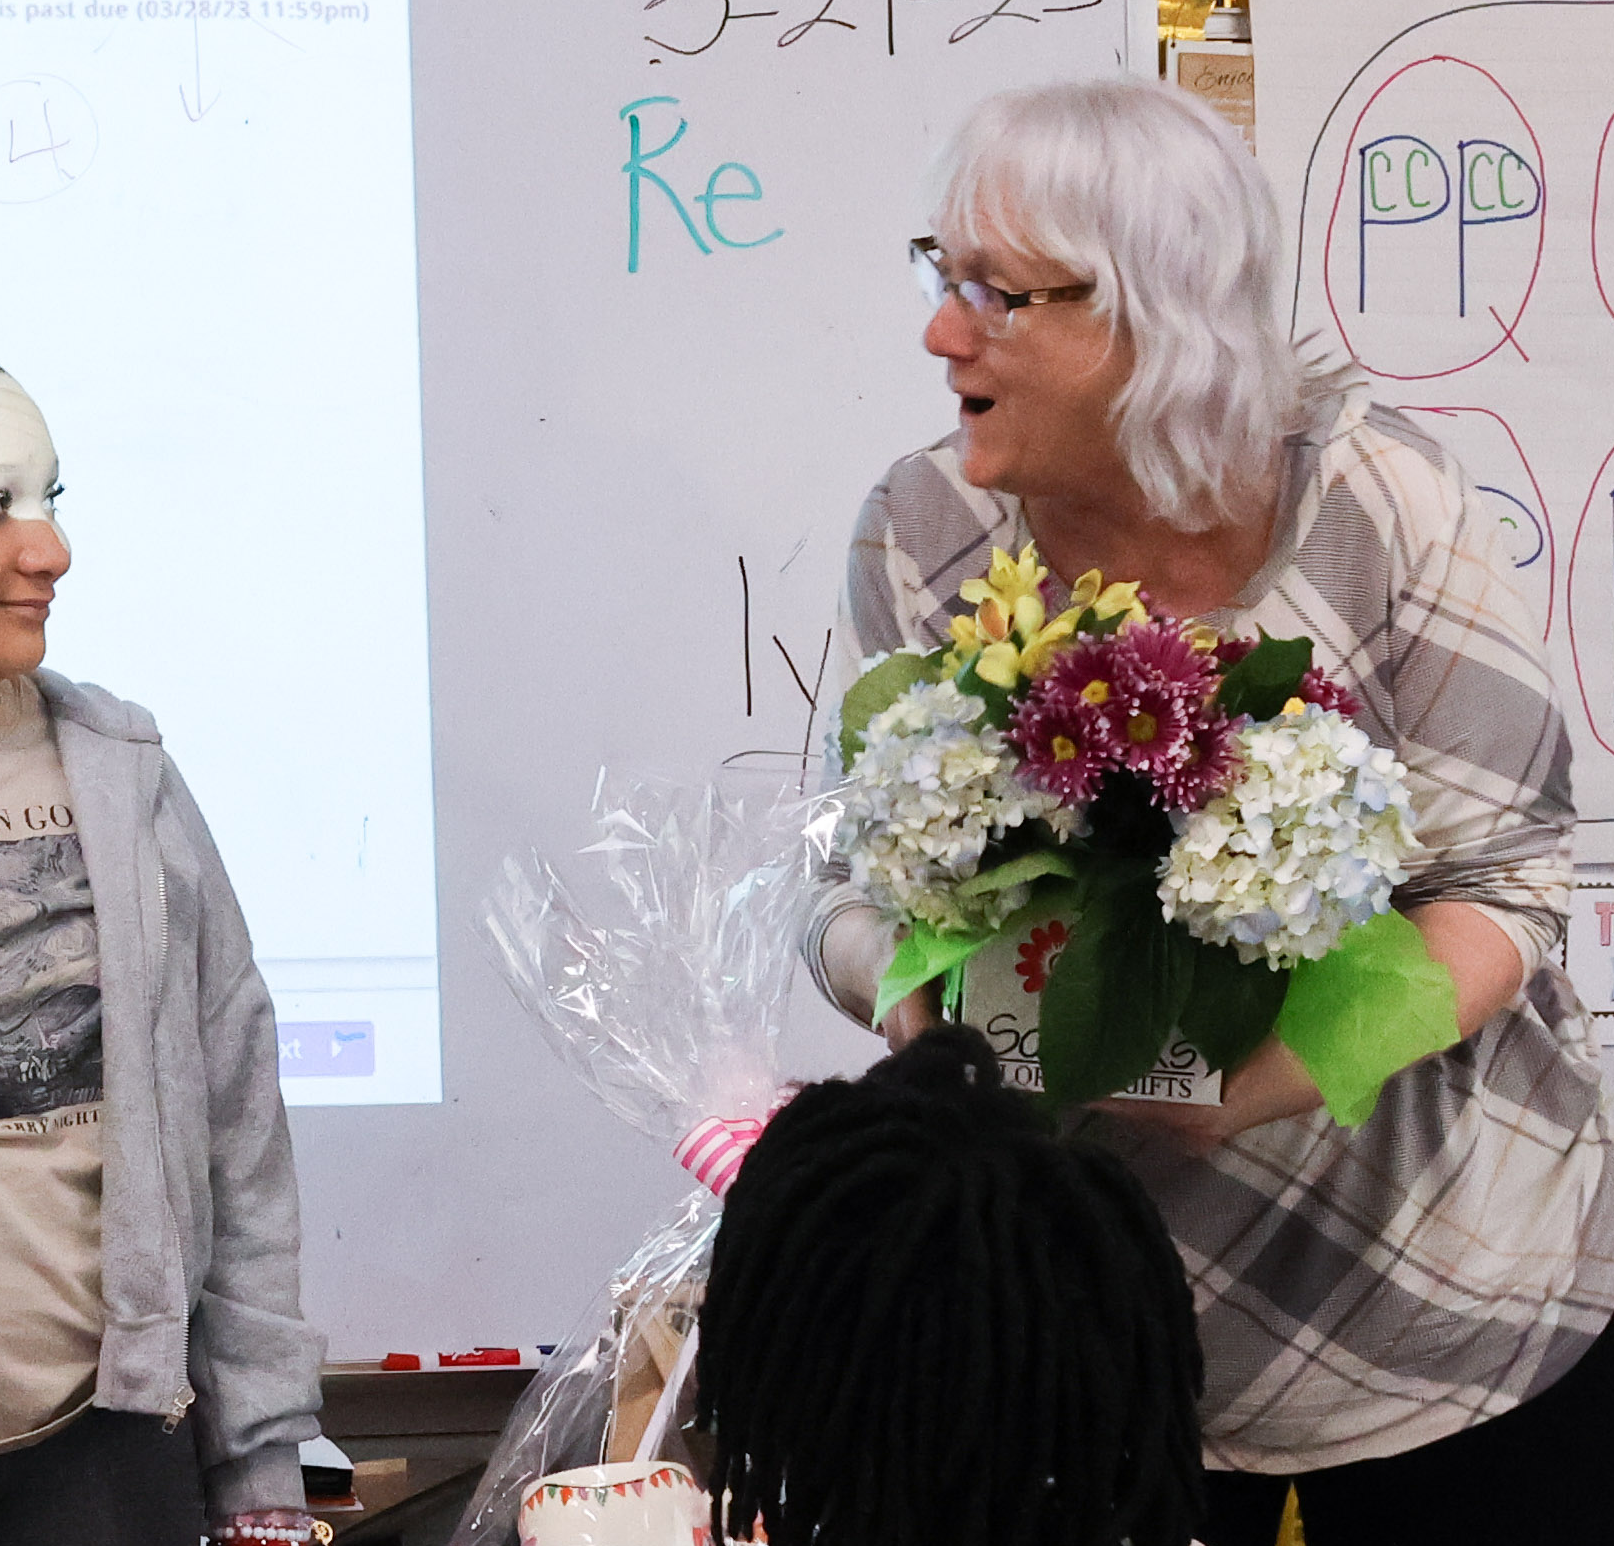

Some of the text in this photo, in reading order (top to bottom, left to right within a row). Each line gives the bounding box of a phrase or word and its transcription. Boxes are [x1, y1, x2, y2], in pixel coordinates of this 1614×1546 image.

[24, 0, 76, 22] past
[82, 0, 130, 19] due
[136, 0, 252, 21] (03/28/23
[259, 0, 371, 23] 11:59pm)
[620, 95, 786, 274] Re
